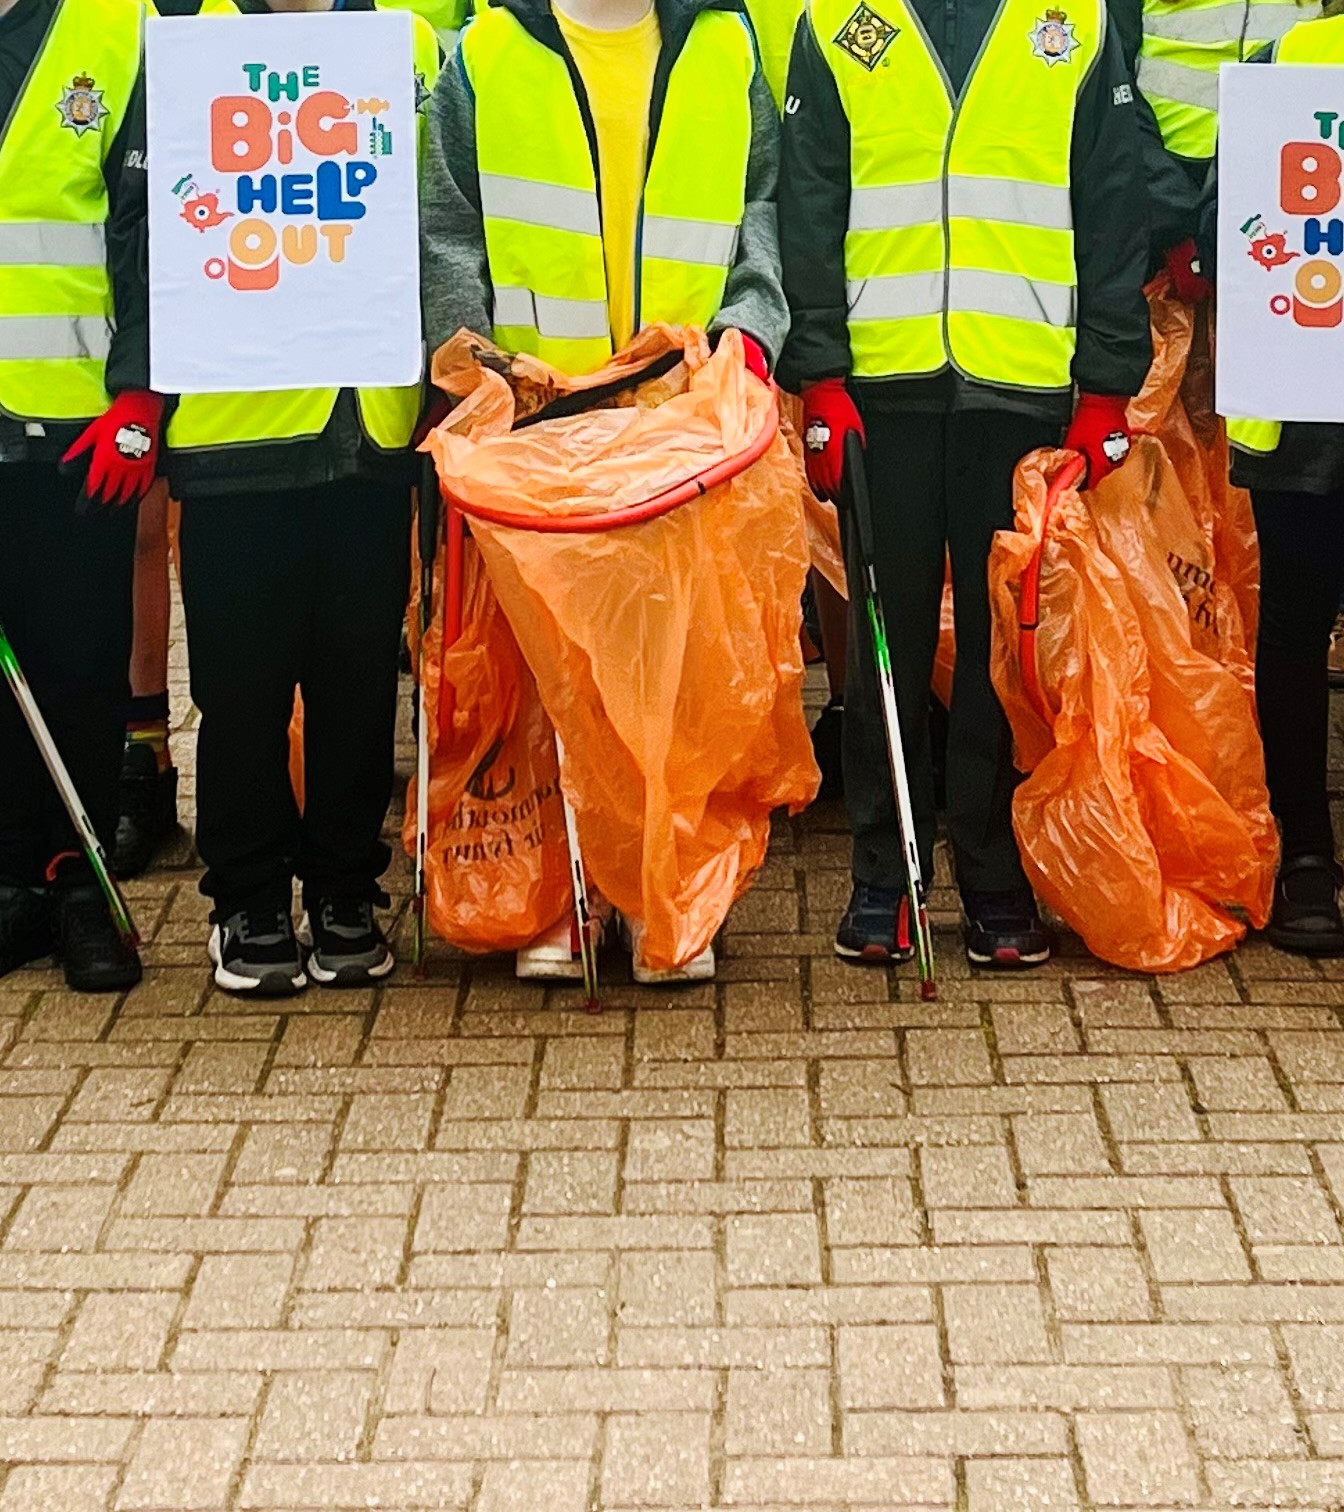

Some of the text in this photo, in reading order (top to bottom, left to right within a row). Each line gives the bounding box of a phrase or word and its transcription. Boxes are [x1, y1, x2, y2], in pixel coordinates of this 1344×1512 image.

[242, 63, 320, 102] THE
[236, 160, 378, 221] HELP
[229, 218, 354, 265] OUT
